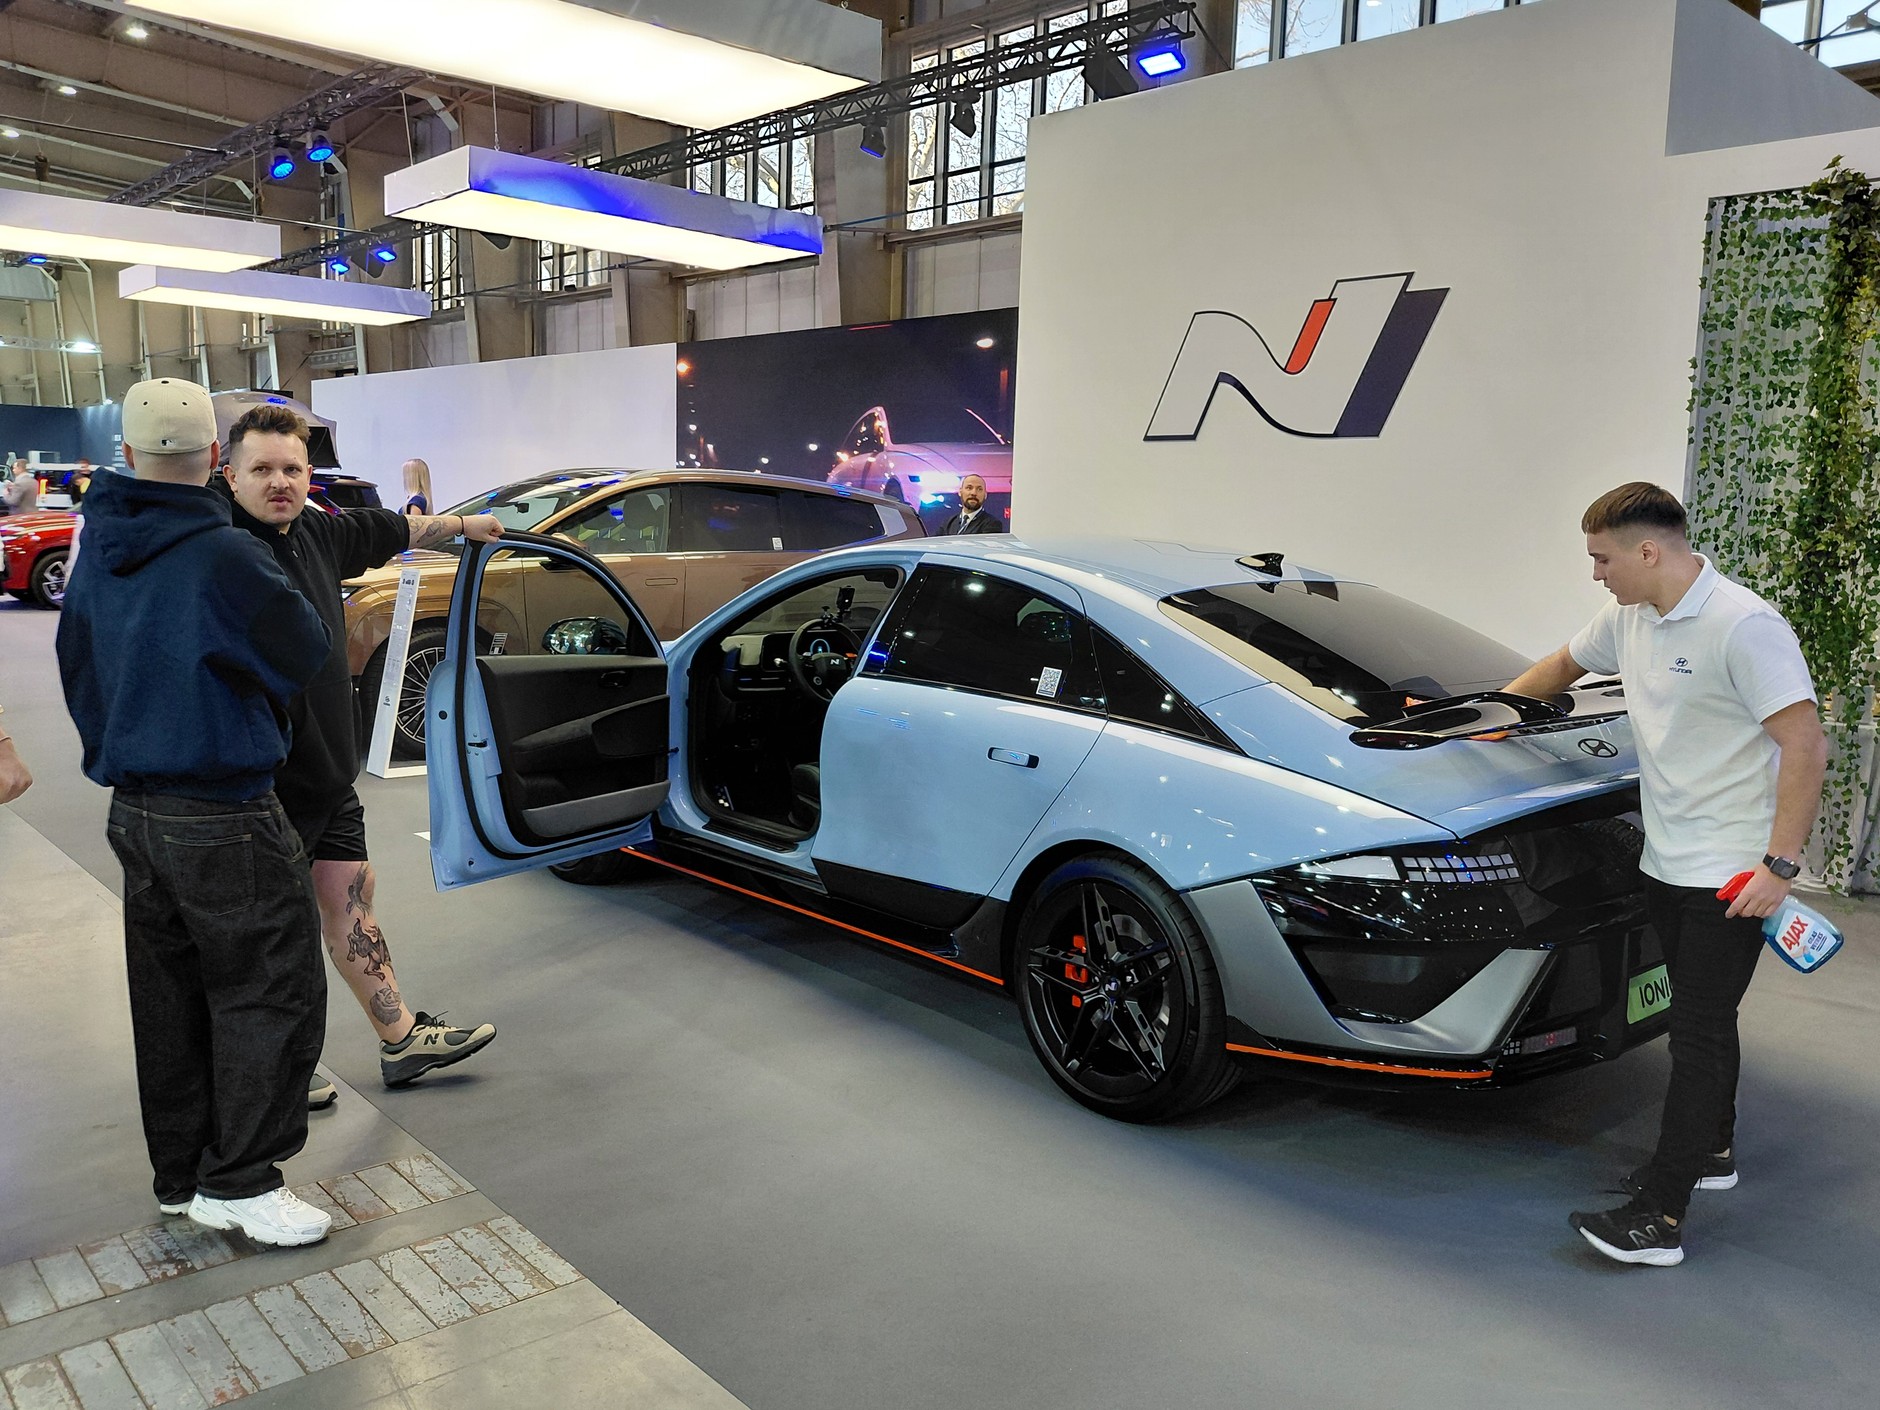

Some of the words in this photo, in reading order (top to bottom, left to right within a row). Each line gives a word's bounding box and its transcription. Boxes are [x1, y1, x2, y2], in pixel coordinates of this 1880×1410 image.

[1143, 271, 1450, 441] N
[1781, 915, 1808, 951] AJAX
[1639, 976, 1670, 1008] IONI
[424, 1033, 440, 1046] N
